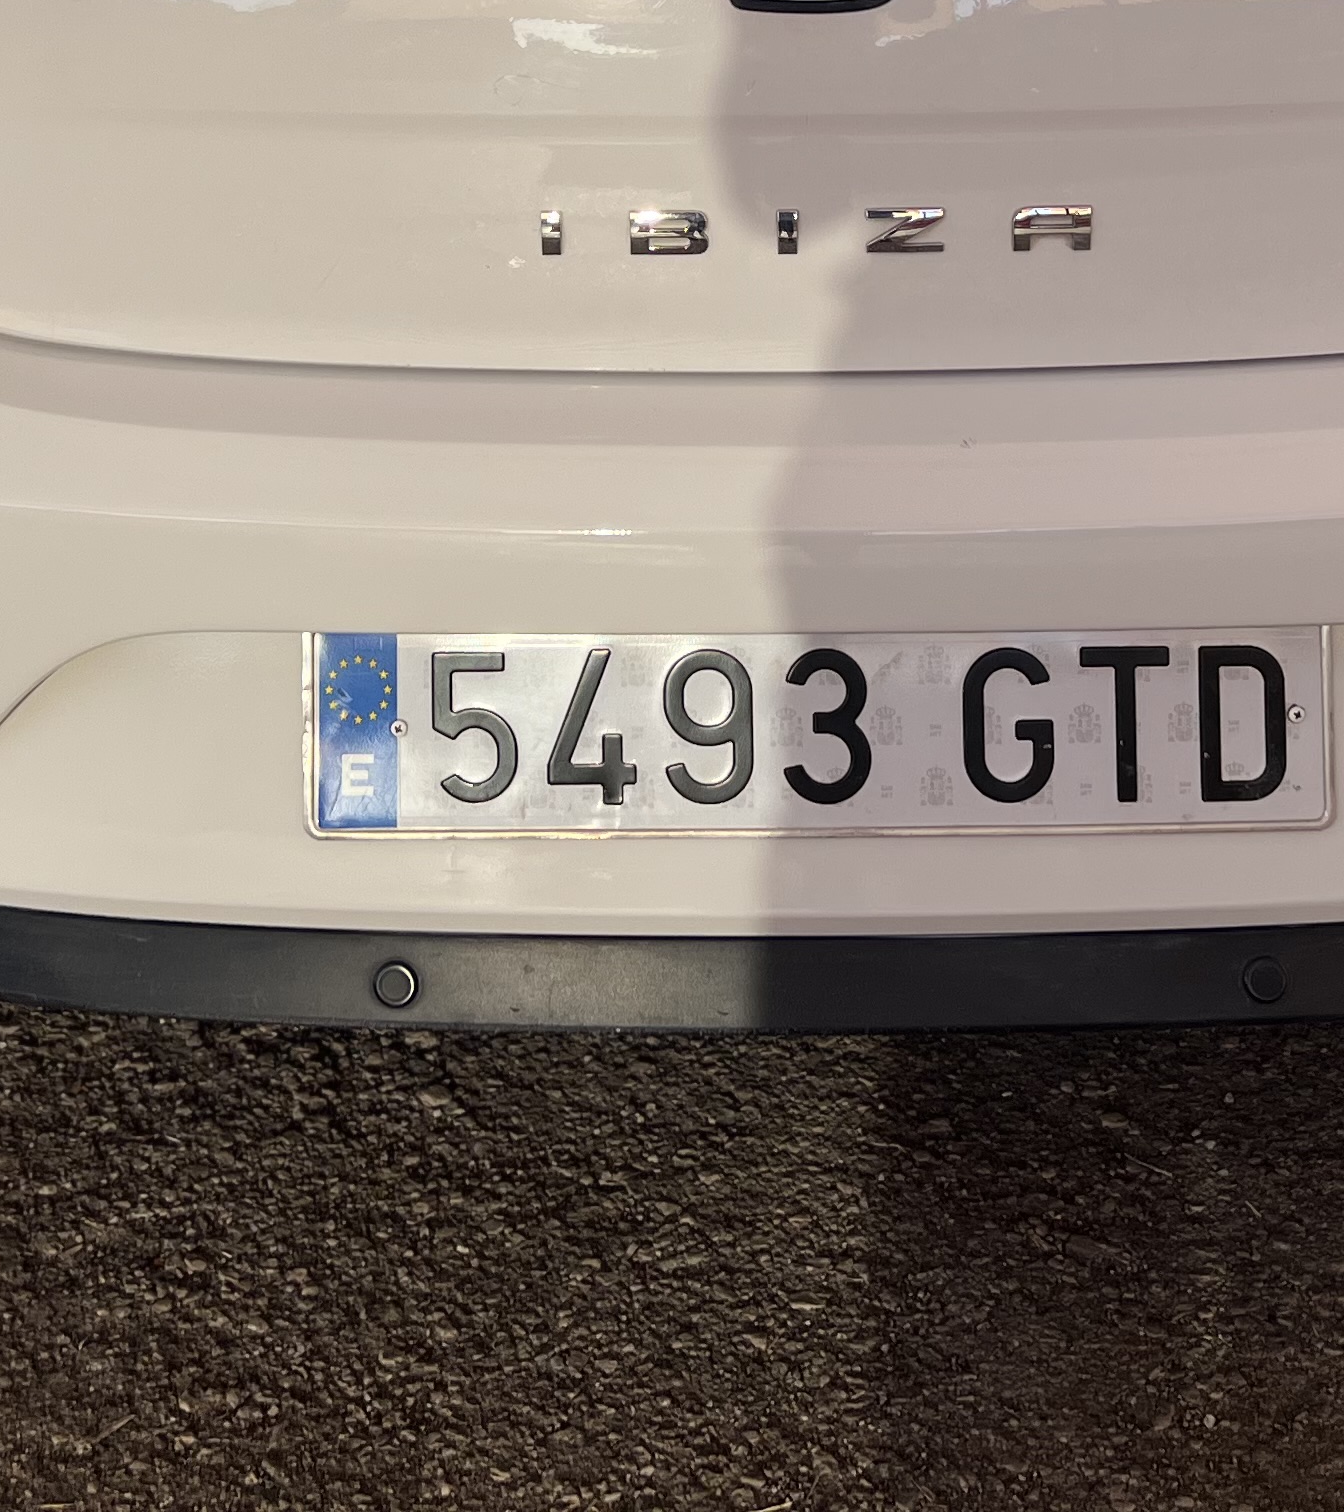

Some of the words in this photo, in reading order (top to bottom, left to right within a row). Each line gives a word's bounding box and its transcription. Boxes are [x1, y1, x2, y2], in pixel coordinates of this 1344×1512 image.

[540, 206, 1093, 255] IBIZA
[430, 648, 873, 806] 5493
[962, 645, 1288, 805] GTD
[342, 753, 375, 797] E
